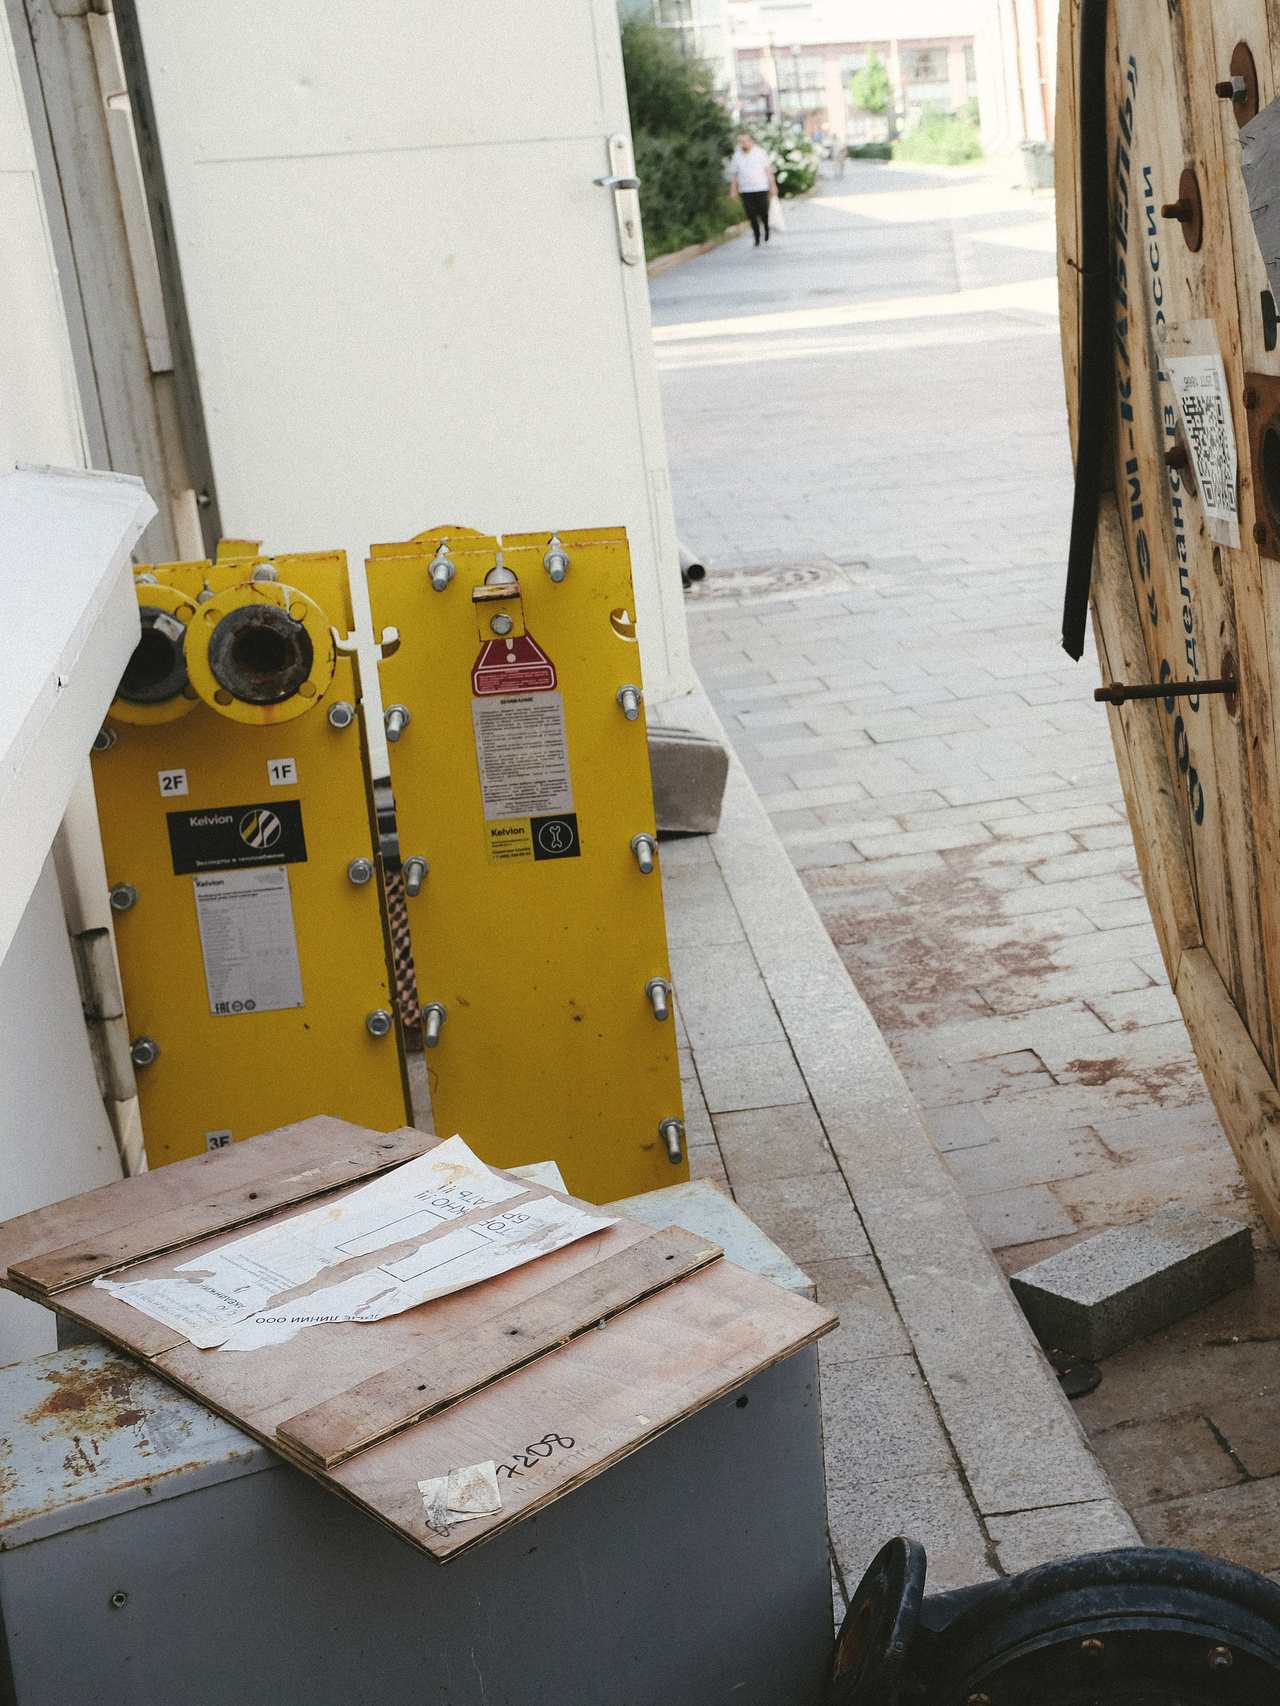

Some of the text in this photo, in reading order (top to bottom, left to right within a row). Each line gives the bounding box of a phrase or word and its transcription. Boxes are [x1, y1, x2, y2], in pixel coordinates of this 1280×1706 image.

[272, 764, 291, 779] 1F
[162, 775, 183, 791] 2F
[189, 814, 233, 827] Kelvion
[491, 827, 525, 837] Kelvion
[210, 1136, 229, 1150] 3F
